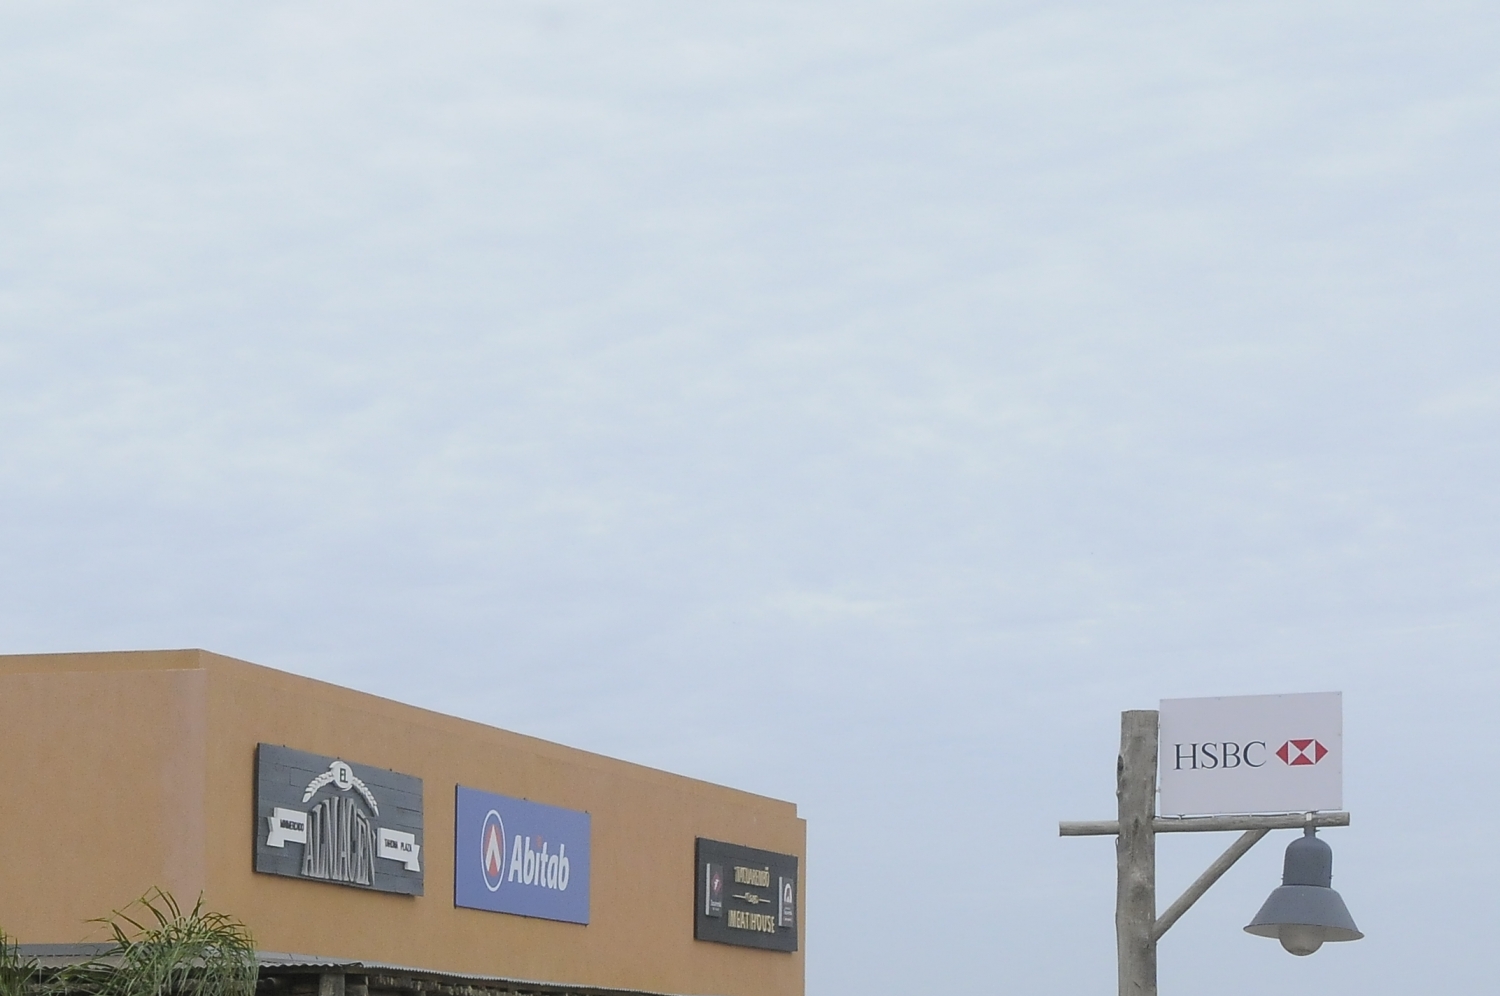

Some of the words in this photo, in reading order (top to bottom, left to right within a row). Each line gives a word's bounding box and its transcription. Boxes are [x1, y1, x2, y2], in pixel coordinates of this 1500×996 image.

[1173, 740, 1267, 770] HSBC
[339, 768, 348, 783] EL
[508, 834, 569, 891] Abitab
[727, 909, 750, 930] MEAT
[750, 912, 775, 934] HOUSE
